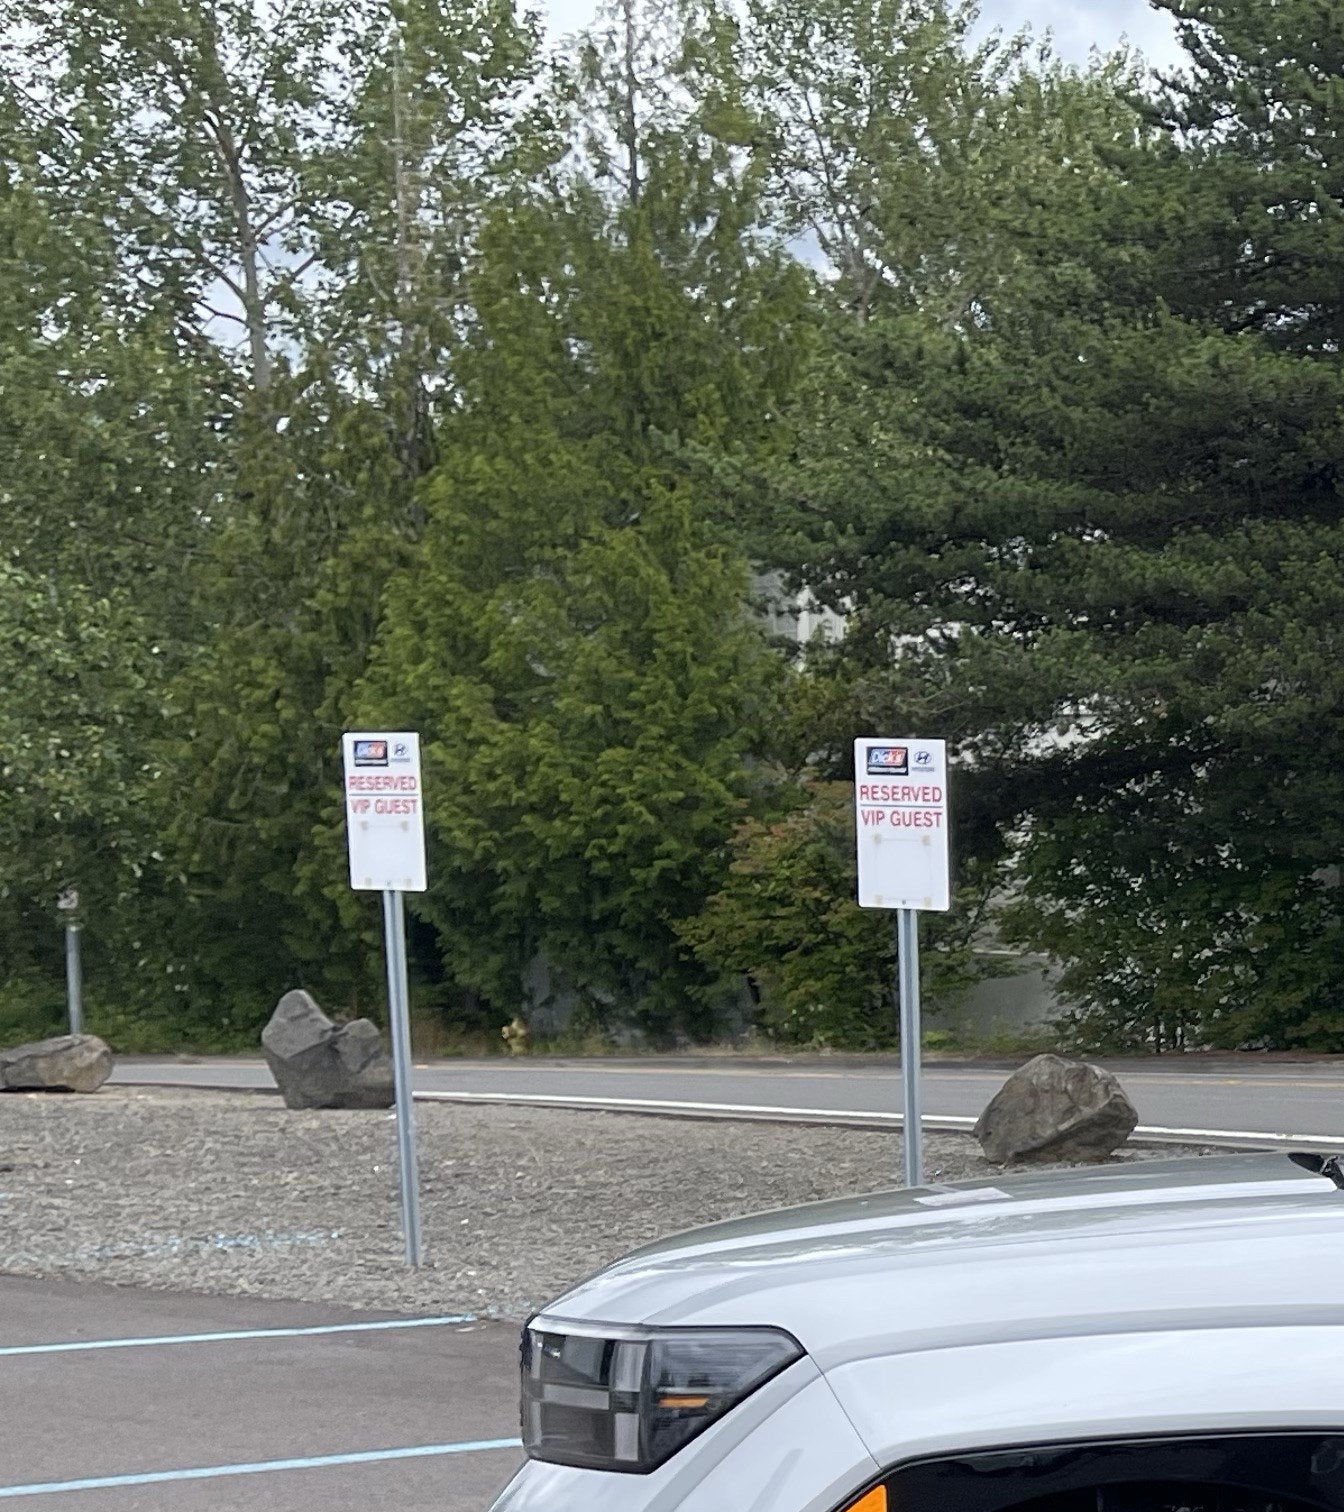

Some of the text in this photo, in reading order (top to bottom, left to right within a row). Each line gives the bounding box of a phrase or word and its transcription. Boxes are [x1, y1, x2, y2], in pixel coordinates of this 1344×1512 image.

[349, 776, 417, 790] RESERVED
[860, 785, 943, 802] RESERVED
[351, 799, 418, 815] VIP GUEST
[861, 810, 943, 828] VIP GUEST
